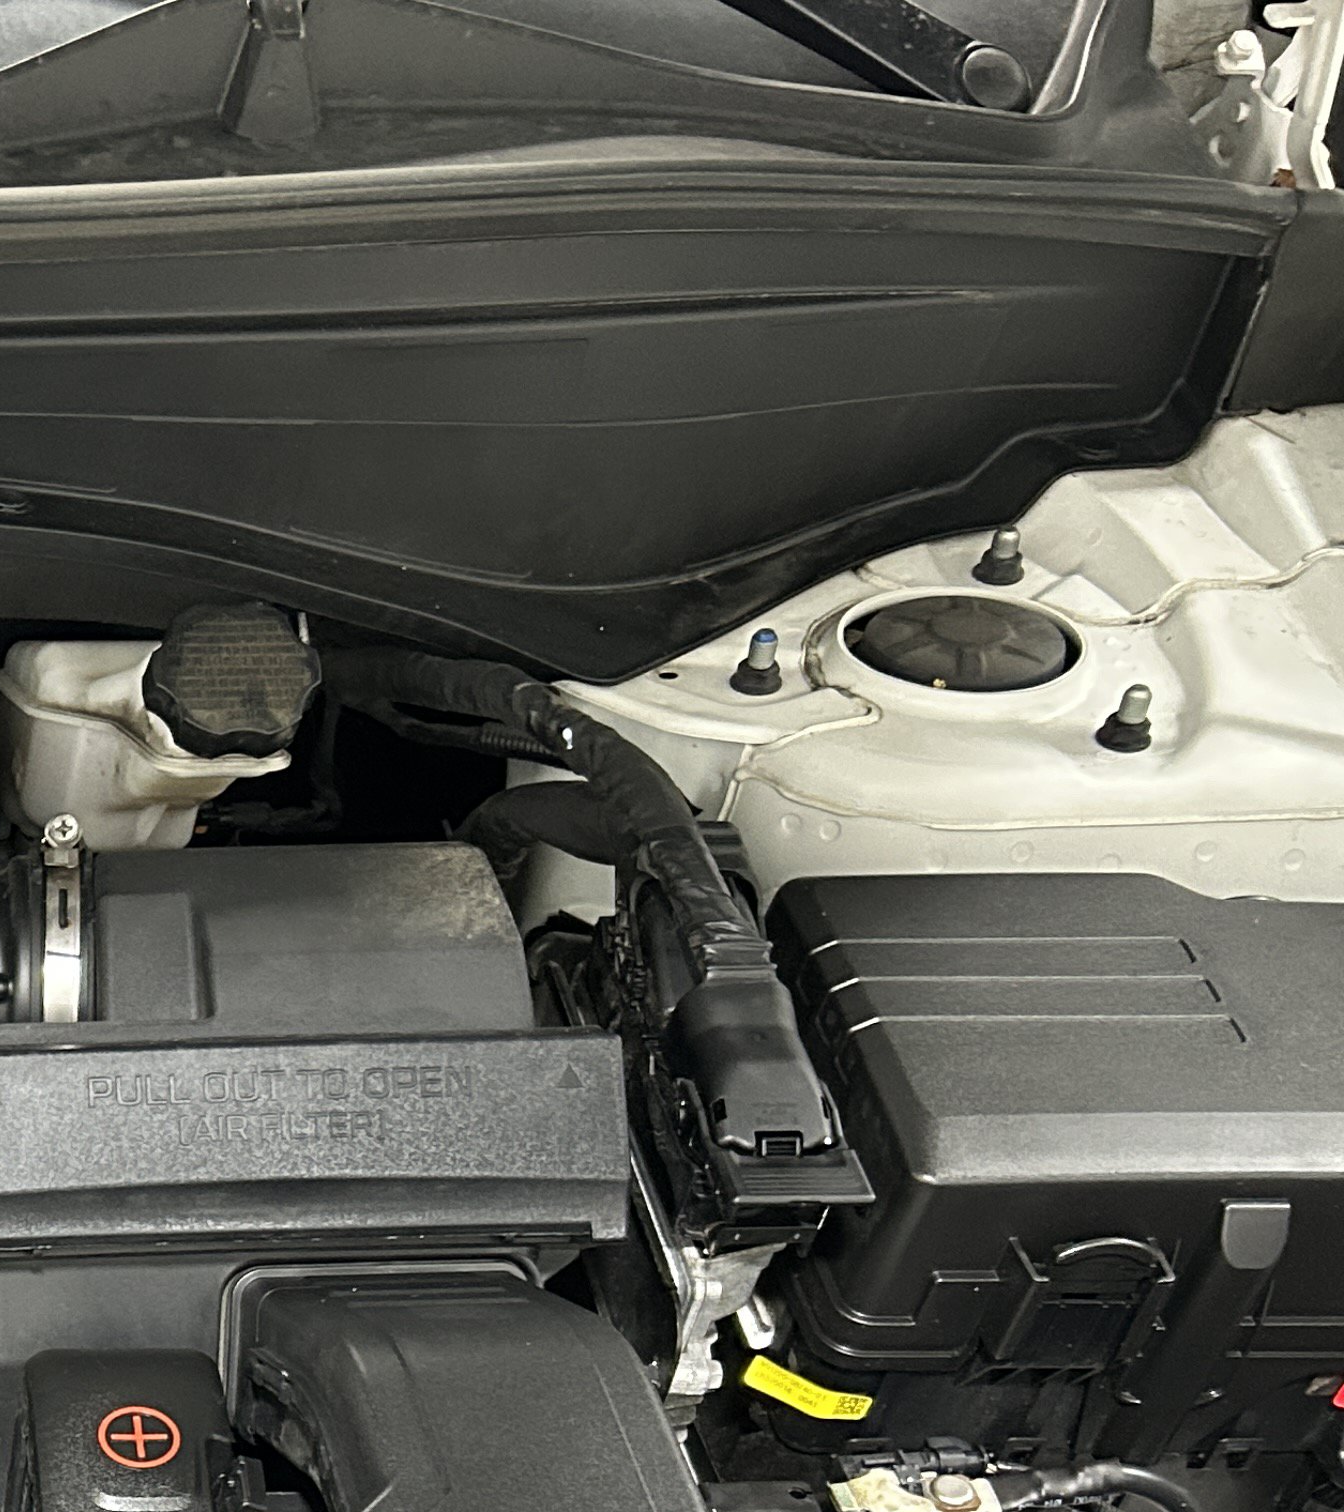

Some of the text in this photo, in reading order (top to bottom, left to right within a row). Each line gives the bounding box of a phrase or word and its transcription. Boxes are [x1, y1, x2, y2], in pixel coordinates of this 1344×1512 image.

[87, 1065, 473, 1108] PULL OUT TO OPEN
